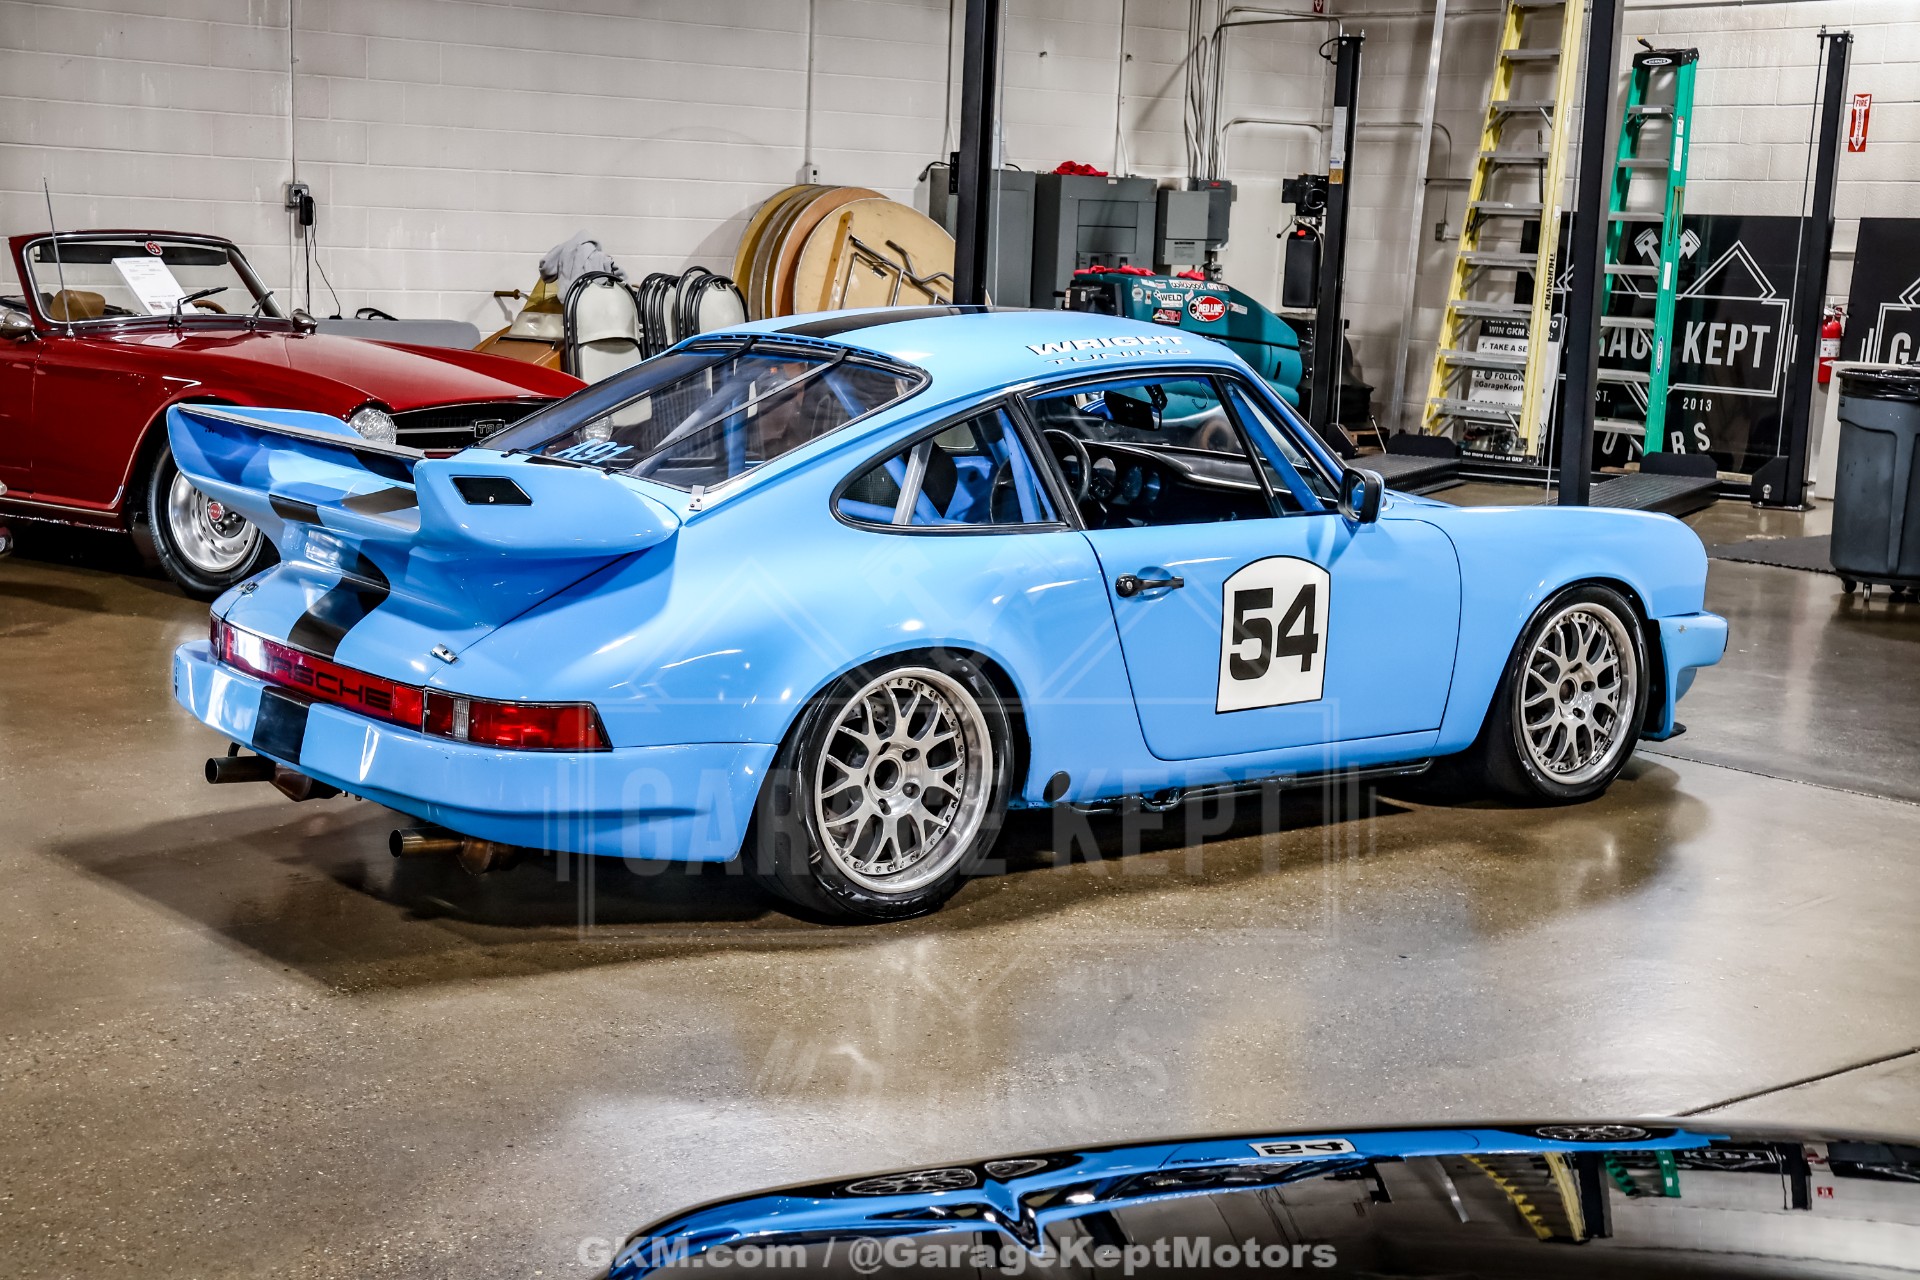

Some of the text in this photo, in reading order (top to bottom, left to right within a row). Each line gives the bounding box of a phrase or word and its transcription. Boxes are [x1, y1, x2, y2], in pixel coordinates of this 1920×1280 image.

[1160, 293, 1183, 302] WELD
[1198, 303, 1210, 312] RED
[1210, 303, 1223, 312] LINE
[1488, 326, 1504, 335] WIN
[1506, 327, 1525, 336] GKM
[1025, 336, 1183, 355] WRIGHT
[1490, 343, 1508, 351] TAKE
[1682, 321, 1771, 368] KEPT
[1045, 348, 1191, 365] TUNING
[1682, 397, 1712, 411] 2013
[1230, 583, 1318, 680] 54
